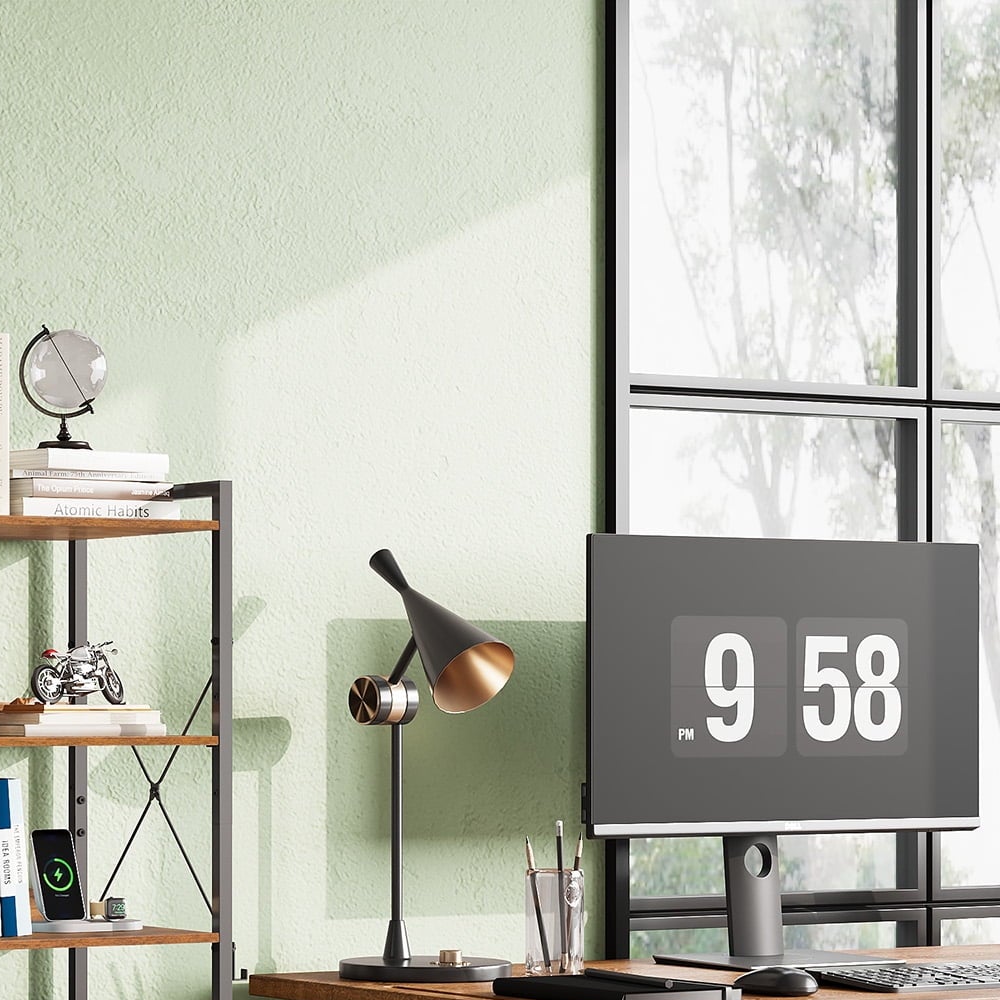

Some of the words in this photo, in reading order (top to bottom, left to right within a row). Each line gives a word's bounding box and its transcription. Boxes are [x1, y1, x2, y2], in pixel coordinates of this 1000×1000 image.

[54, 503, 102, 516] Atomic
[107, 504, 150, 518] Habits
[704, 632, 755, 743] 9
[802, 634, 902, 742] 58
[678, 728, 694, 741] PM
[1, 840, 10, 858] IDEA
[2, 859, 12, 885] ROOMS
